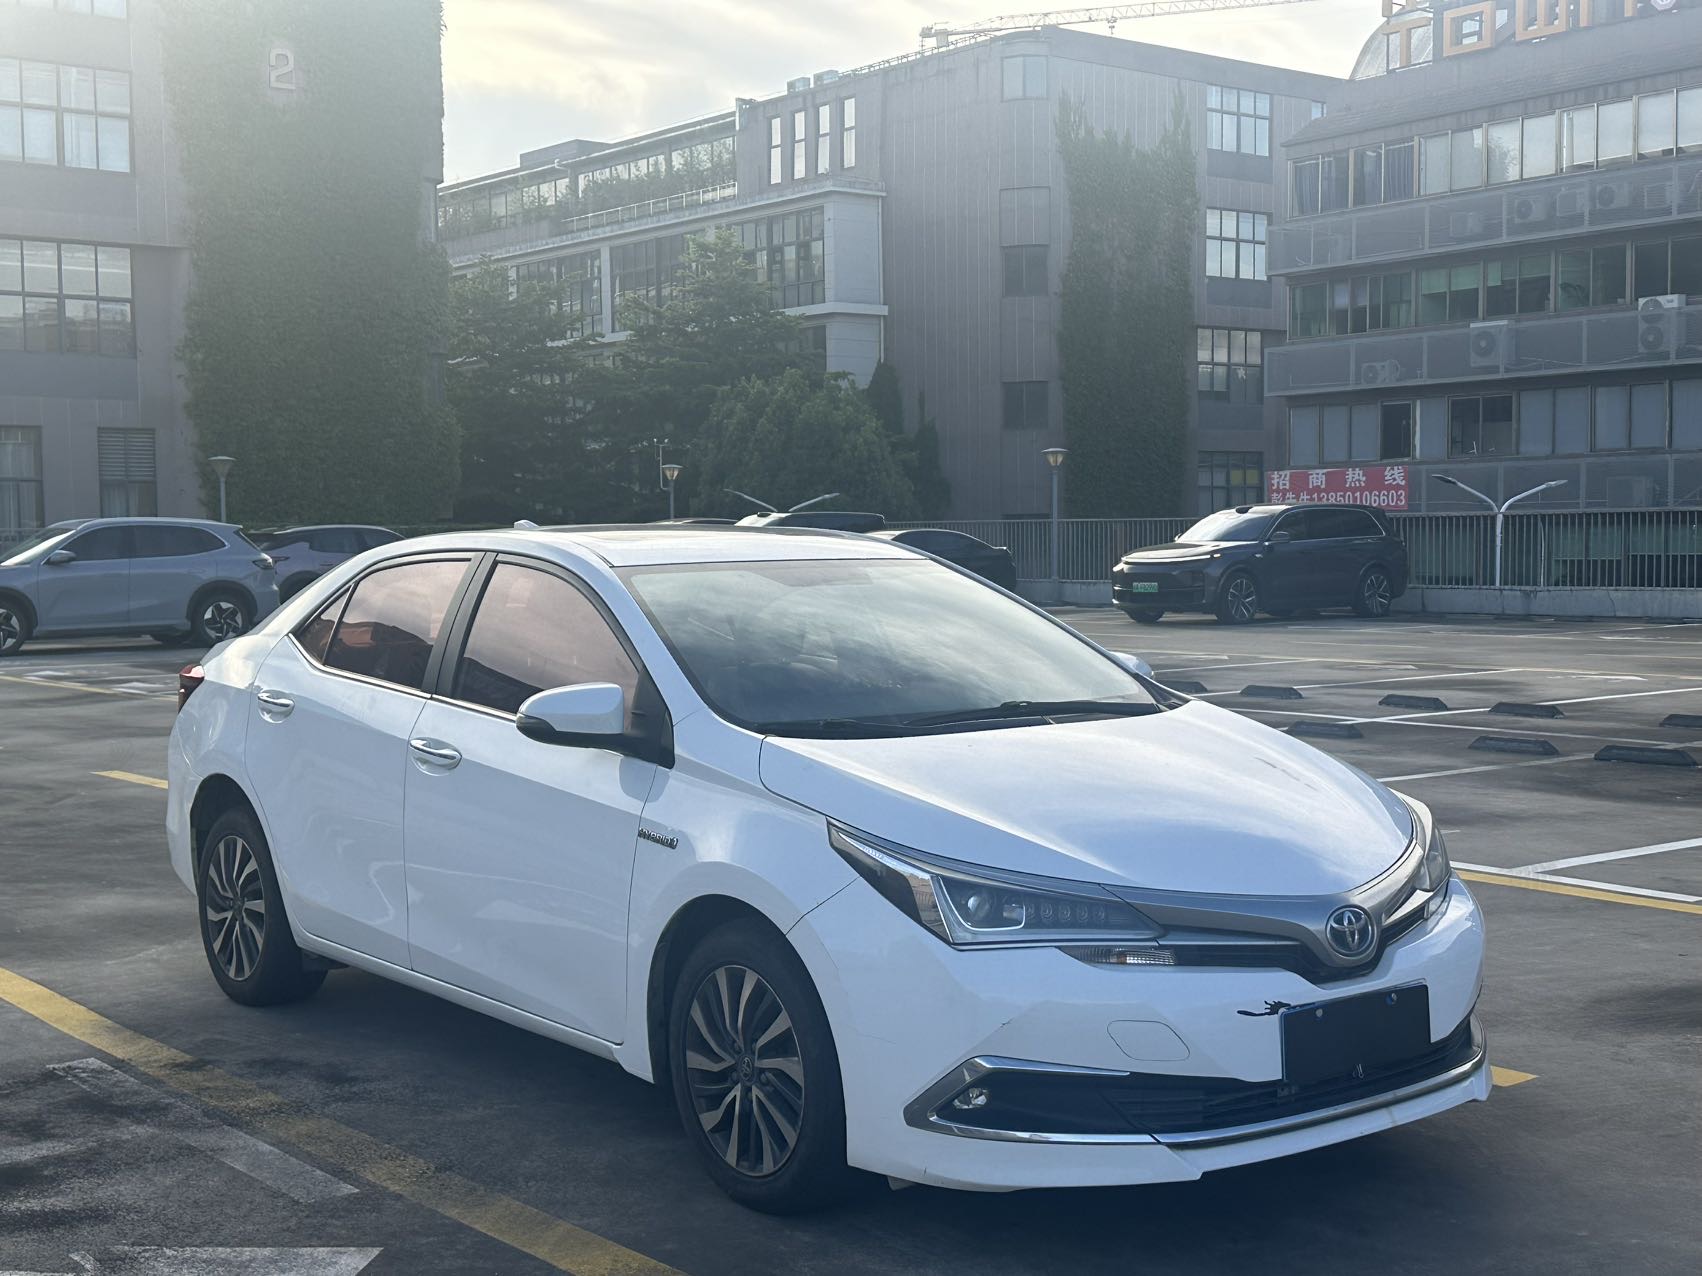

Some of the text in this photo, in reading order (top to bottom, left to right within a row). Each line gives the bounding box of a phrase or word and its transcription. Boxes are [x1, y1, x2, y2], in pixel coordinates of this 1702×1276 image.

[269, 48, 297, 90] 2
[1271, 466, 1406, 490] 招商热线
